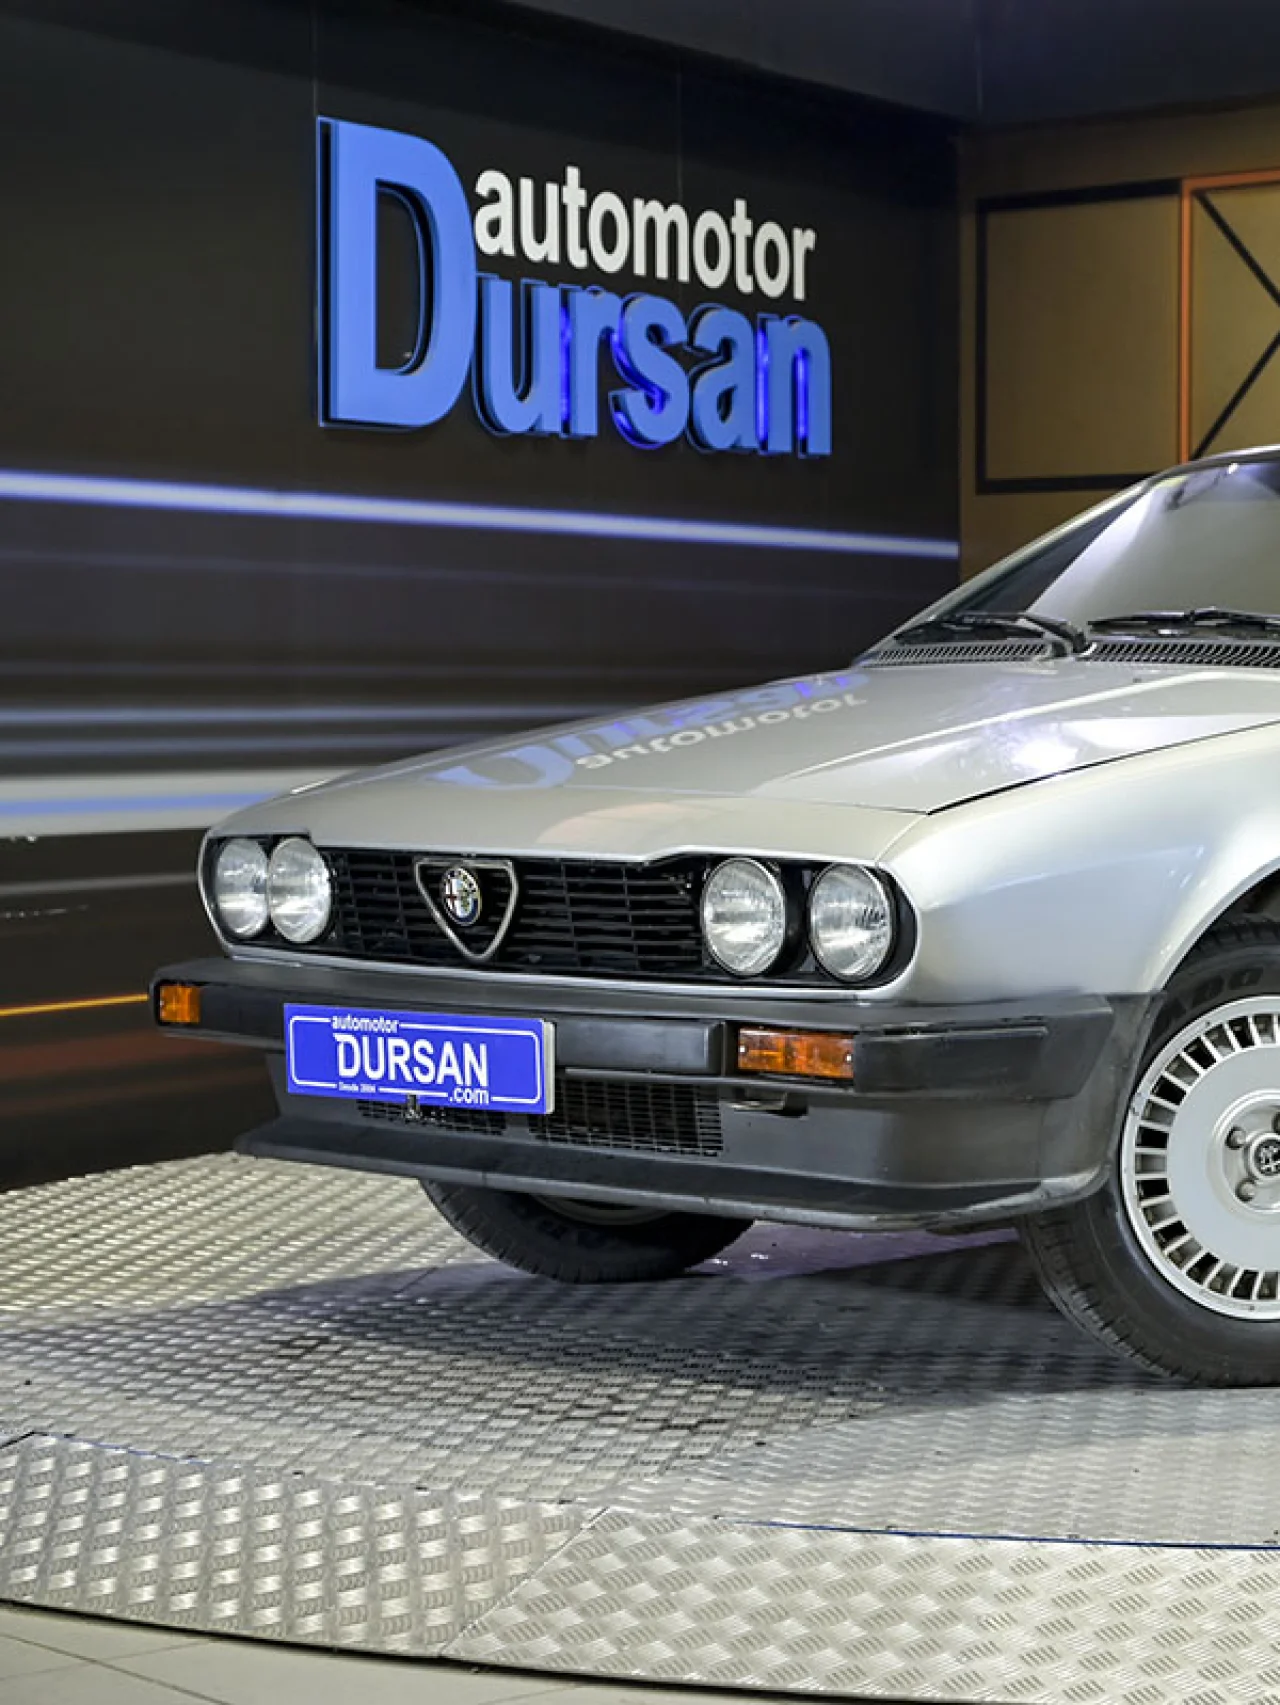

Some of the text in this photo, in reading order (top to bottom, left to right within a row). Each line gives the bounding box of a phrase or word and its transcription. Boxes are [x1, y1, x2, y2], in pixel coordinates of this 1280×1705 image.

[474, 165, 816, 300] automotor
[317, 115, 832, 457] Dursan
[332, 1013, 399, 1034] automotor
[333, 1032, 489, 1087] DURSAN
[449, 1087, 490, 1105] .com
